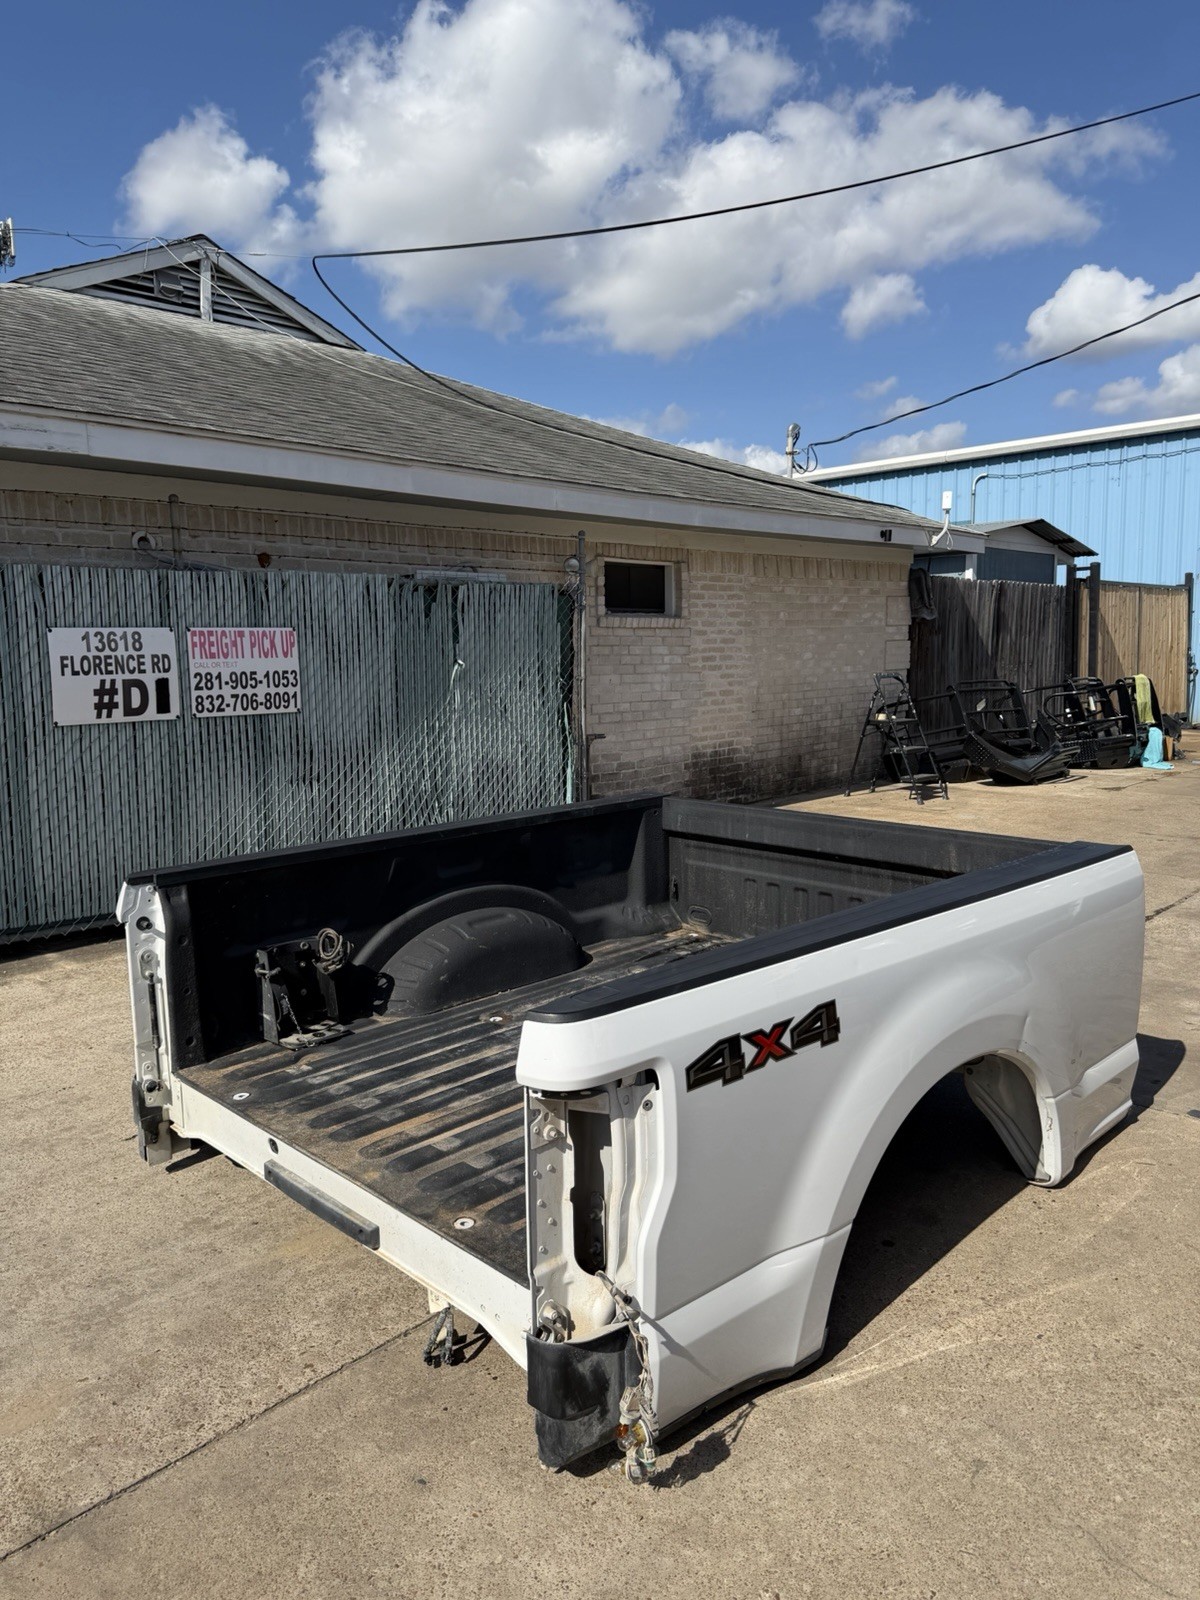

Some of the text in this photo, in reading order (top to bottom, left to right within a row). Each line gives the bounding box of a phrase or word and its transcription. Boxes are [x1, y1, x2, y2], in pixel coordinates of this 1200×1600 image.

[81, 630, 143, 653] 13618
[190, 629, 296, 660] FREIGHT PICK UP
[59, 653, 172, 677] FLORENCE RD
[193, 661, 238, 669] CALL OR TEXT
[193, 669, 299, 691] 281-905-1053
[194, 691, 299, 714] 832-706-8091
